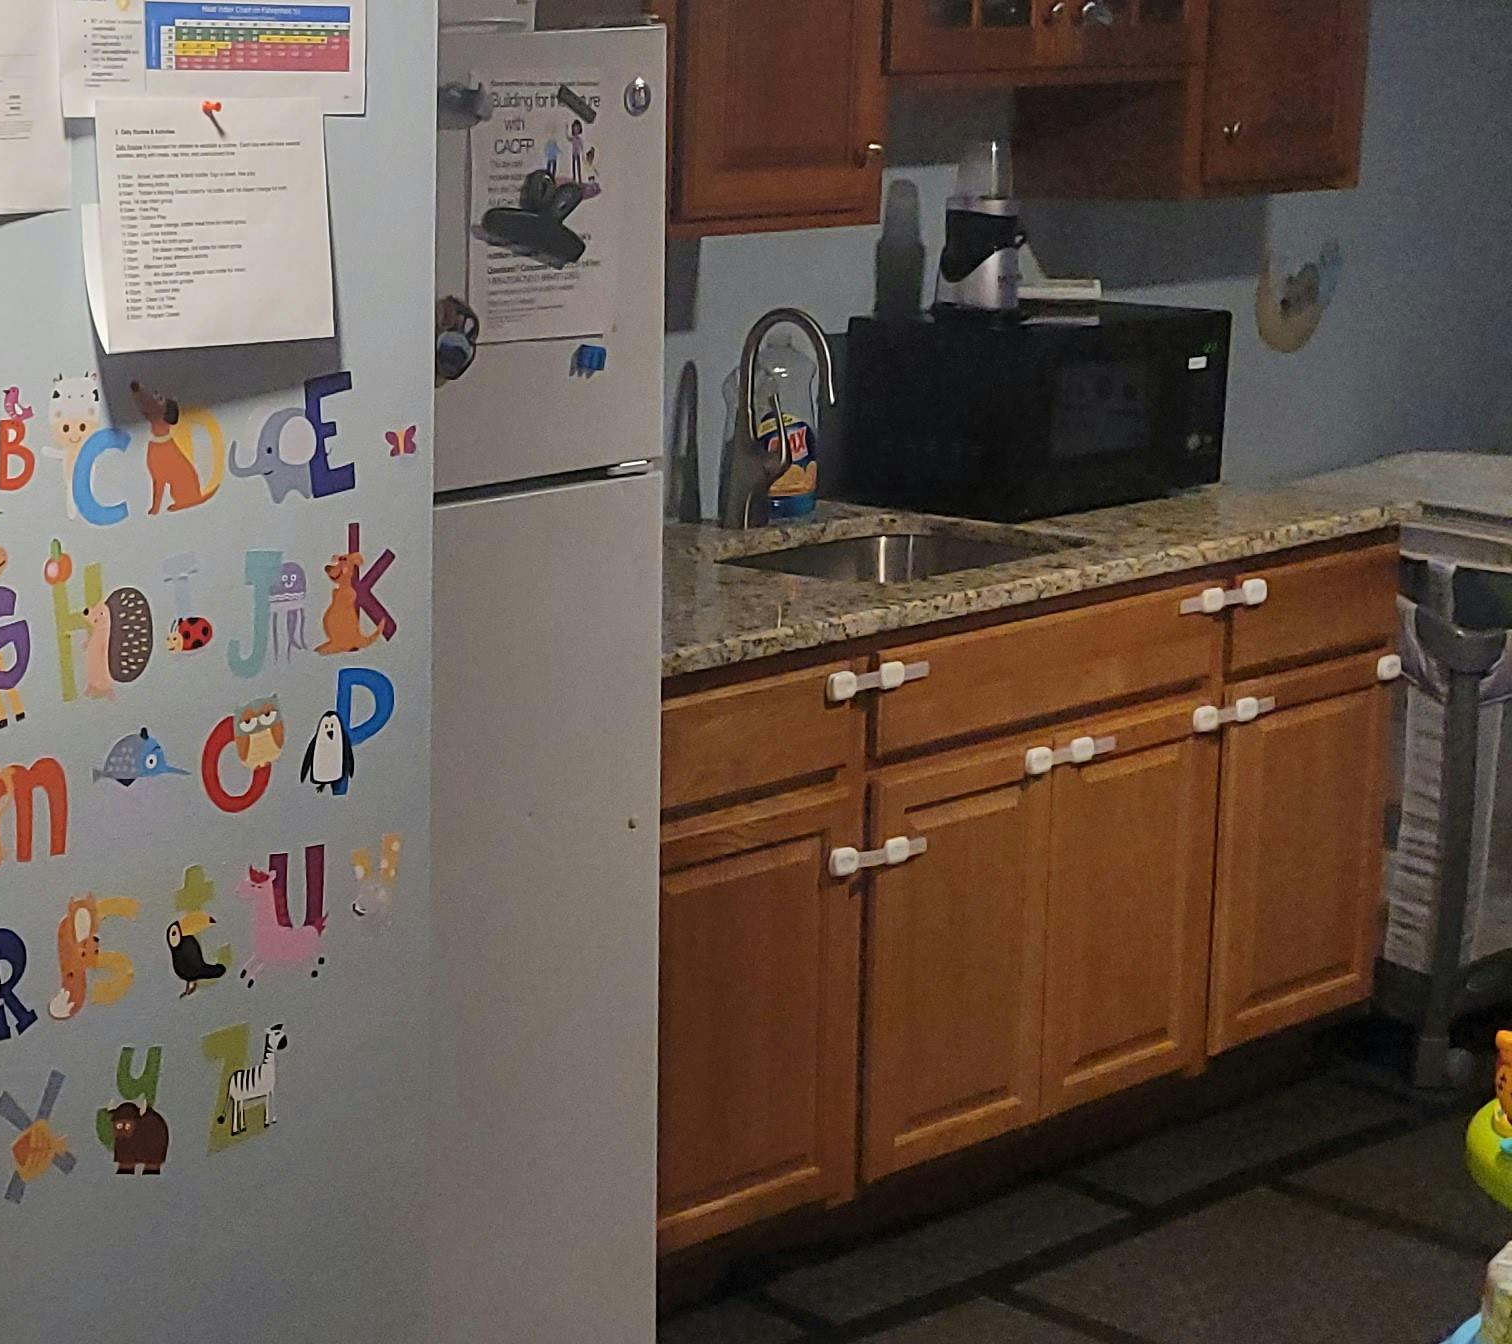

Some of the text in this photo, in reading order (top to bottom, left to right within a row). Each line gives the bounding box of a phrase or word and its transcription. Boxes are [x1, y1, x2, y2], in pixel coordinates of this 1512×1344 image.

[72, 426, 132, 527] C
[304, 370, 356, 498] E
[50, 561, 105, 702] H
[227, 549, 285, 678] J
[347, 522, 397, 642] K
[202, 715, 272, 813] O
[335, 666, 395, 796] P
[268, 843, 326, 929] U
[201, 1023, 269, 1156] Z
